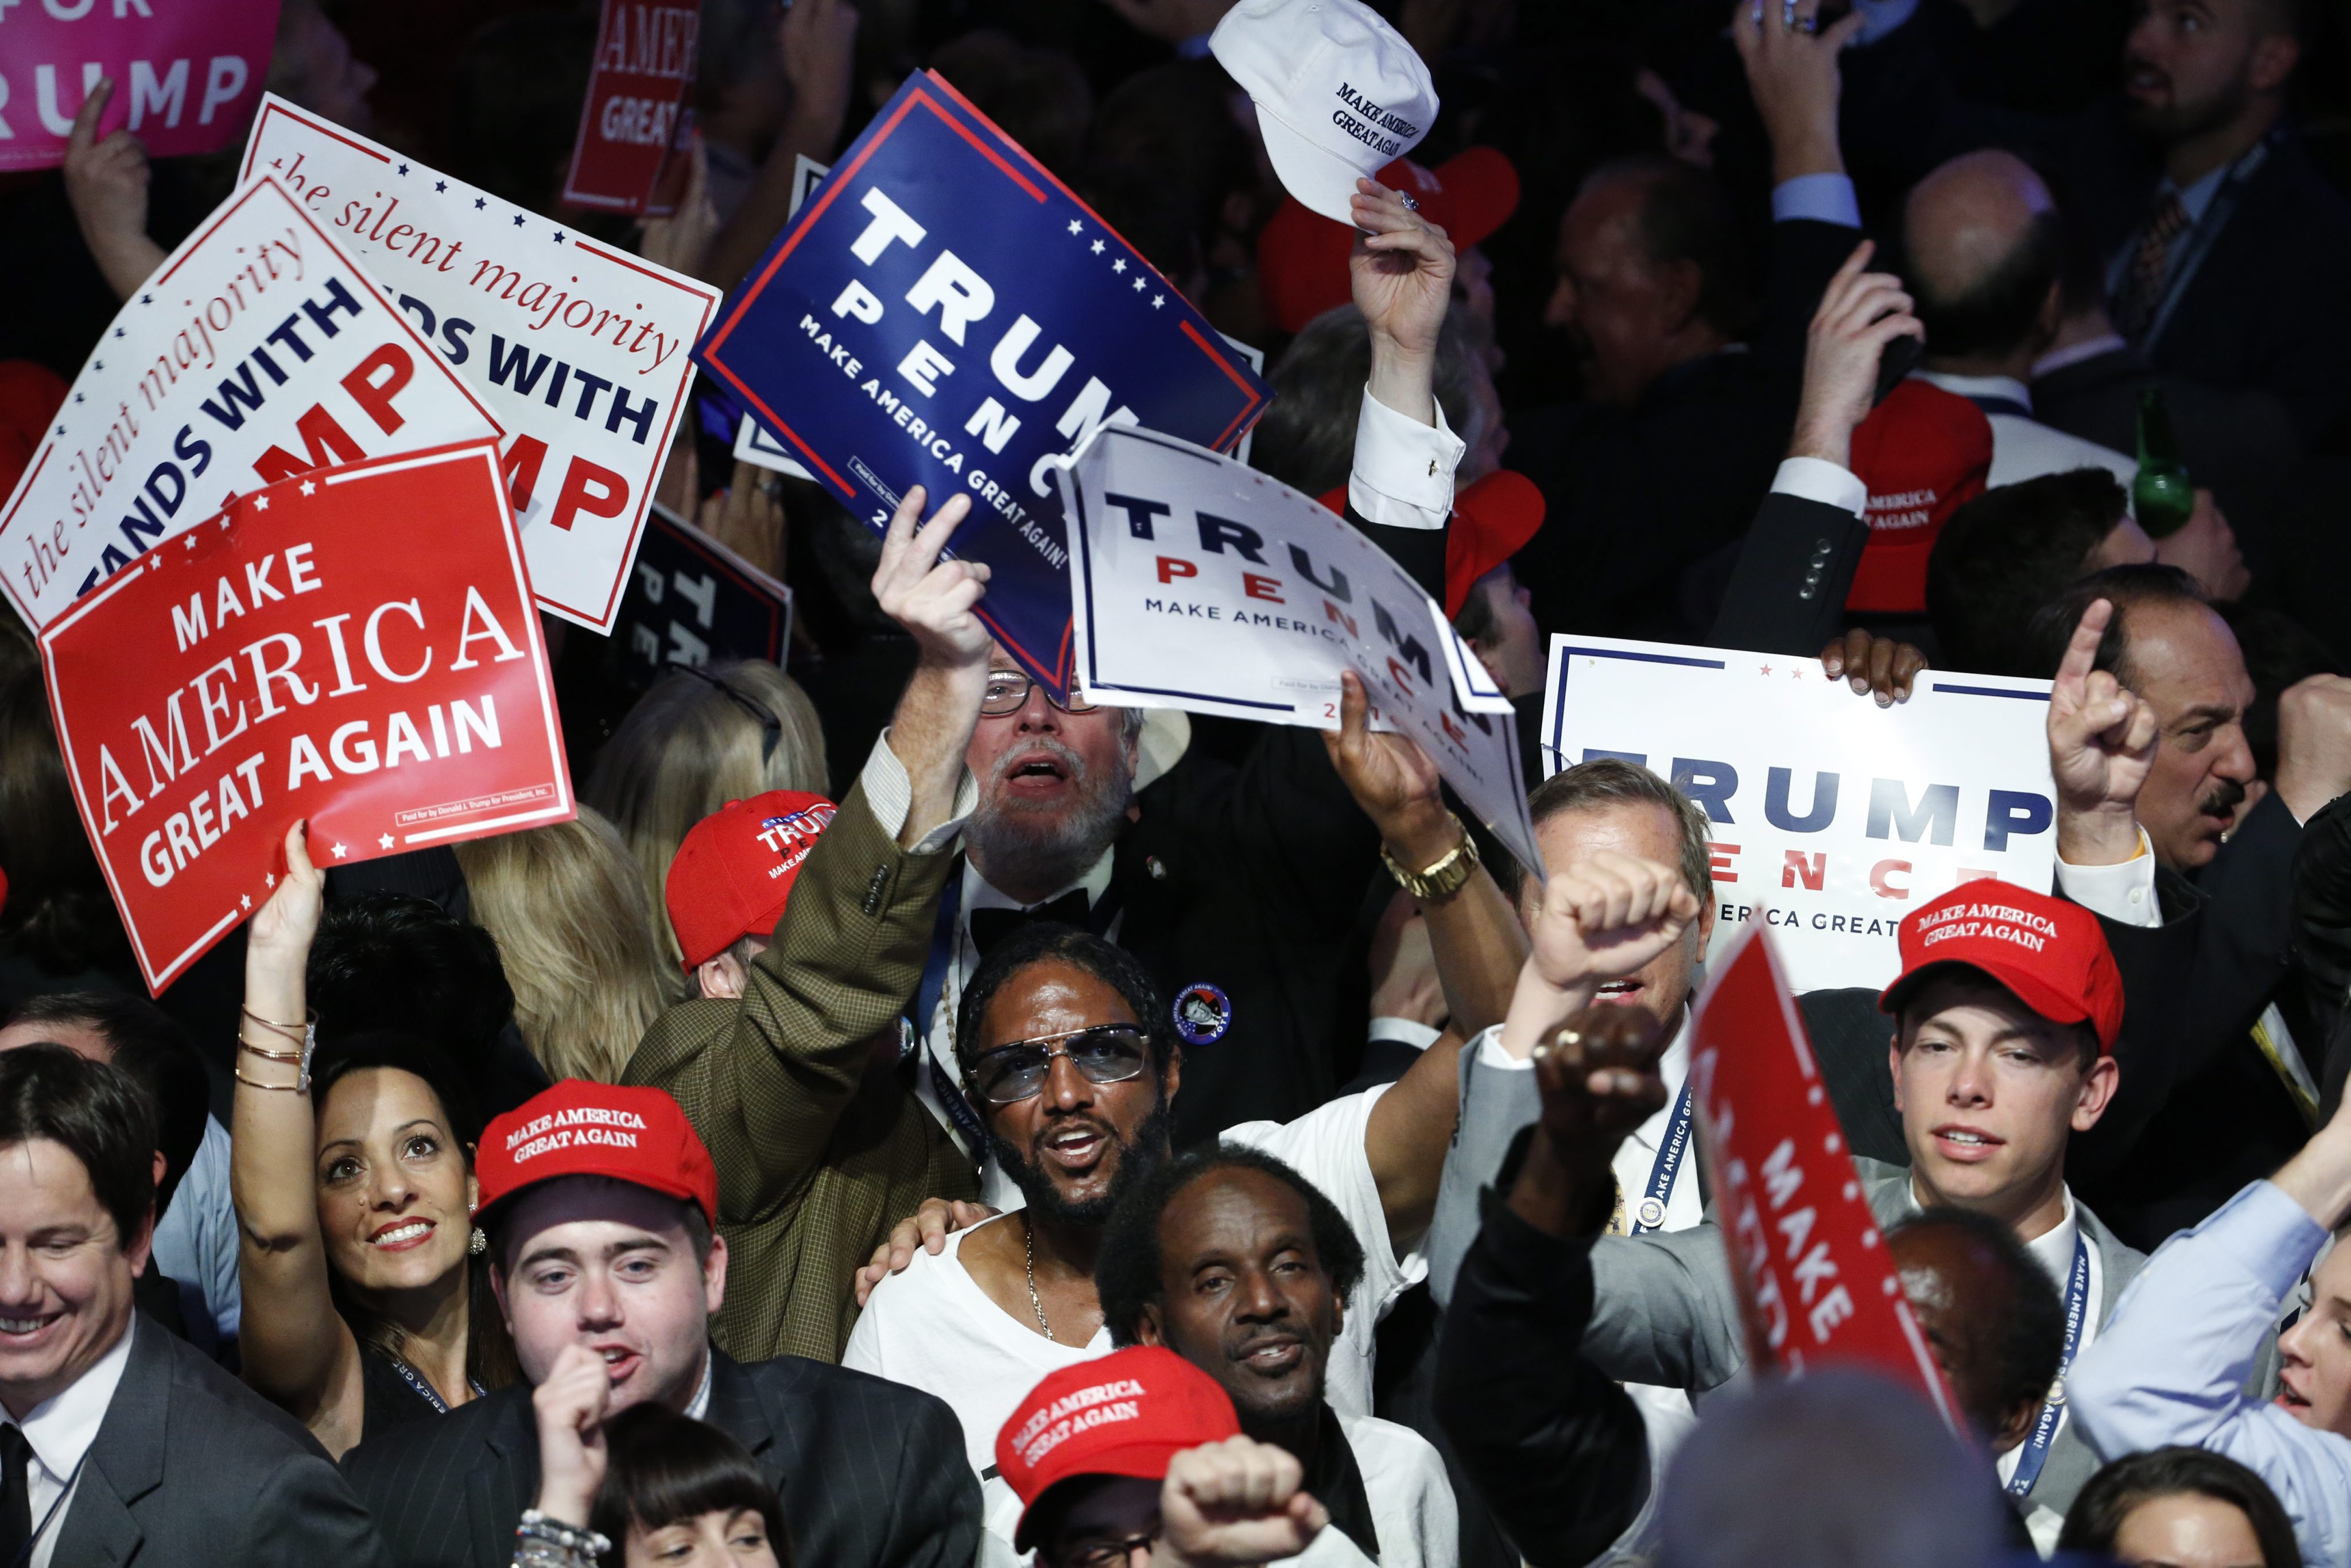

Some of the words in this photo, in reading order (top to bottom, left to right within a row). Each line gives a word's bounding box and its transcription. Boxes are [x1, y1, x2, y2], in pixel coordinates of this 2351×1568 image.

[0, 56, 248, 139] UMP
[1336, 82, 1383, 122] MAKE
[1333, 110, 1379, 146] GREAT
[335, 191, 463, 273] silent
[470, 257, 680, 375] majority
[200, 277, 364, 431] WITH
[488, 333, 659, 445] WITH
[23, 519, 69, 599] the
[69, 402, 139, 529] silent
[138, 228, 304, 412] majority
[800, 314, 863, 379] MAKE
[862, 379, 964, 473] AMERICA
[968, 470, 1025, 525] GREAT
[1019, 521, 1068, 570] AGAIN!
[171, 542, 322, 652] MAKE
[1145, 599, 1222, 620] MAKE
[1233, 611, 1350, 649] AMERICA
[102, 585, 525, 837] AMERICA
[140, 751, 266, 888] GREAT
[287, 693, 503, 791] AGAIN
[402, 811, 417, 822] Paid
[418, 809, 428, 820] for
[428, 808, 438, 818] by
[437, 804, 463, 816] Donald
[470, 799, 491, 810] Trump
[491, 796, 502, 805] for
[768, 858, 797, 879] MAKE
[1706, 841, 1997, 899] ENC
[1721, 903, 1800, 928] ERCA
[1811, 912, 1899, 937] GREAT
[1917, 905, 1965, 933] MAKE
[1966, 903, 2058, 938] AMERICA
[1925, 922, 1980, 947] GREAT
[1980, 922, 2046, 953] AGAIN
[1211, 1011, 1228, 1038] VOTE
[506, 1114, 552, 1150] MAKE
[554, 1108, 647, 1130] AMERICA
[514, 1130, 571, 1164] GREAT
[574, 1129, 637, 1148] AGAIN
[1655, 1173, 1670, 1200] AKE
[1666, 1120, 1688, 1172] AMERICA
[1760, 1137, 1855, 1344] MAKE
[2074, 1255, 2086, 1291] MAKE
[1049, 1379, 1146, 1421] AMERICA
[1072, 1400, 1139, 1434] AGAIN
